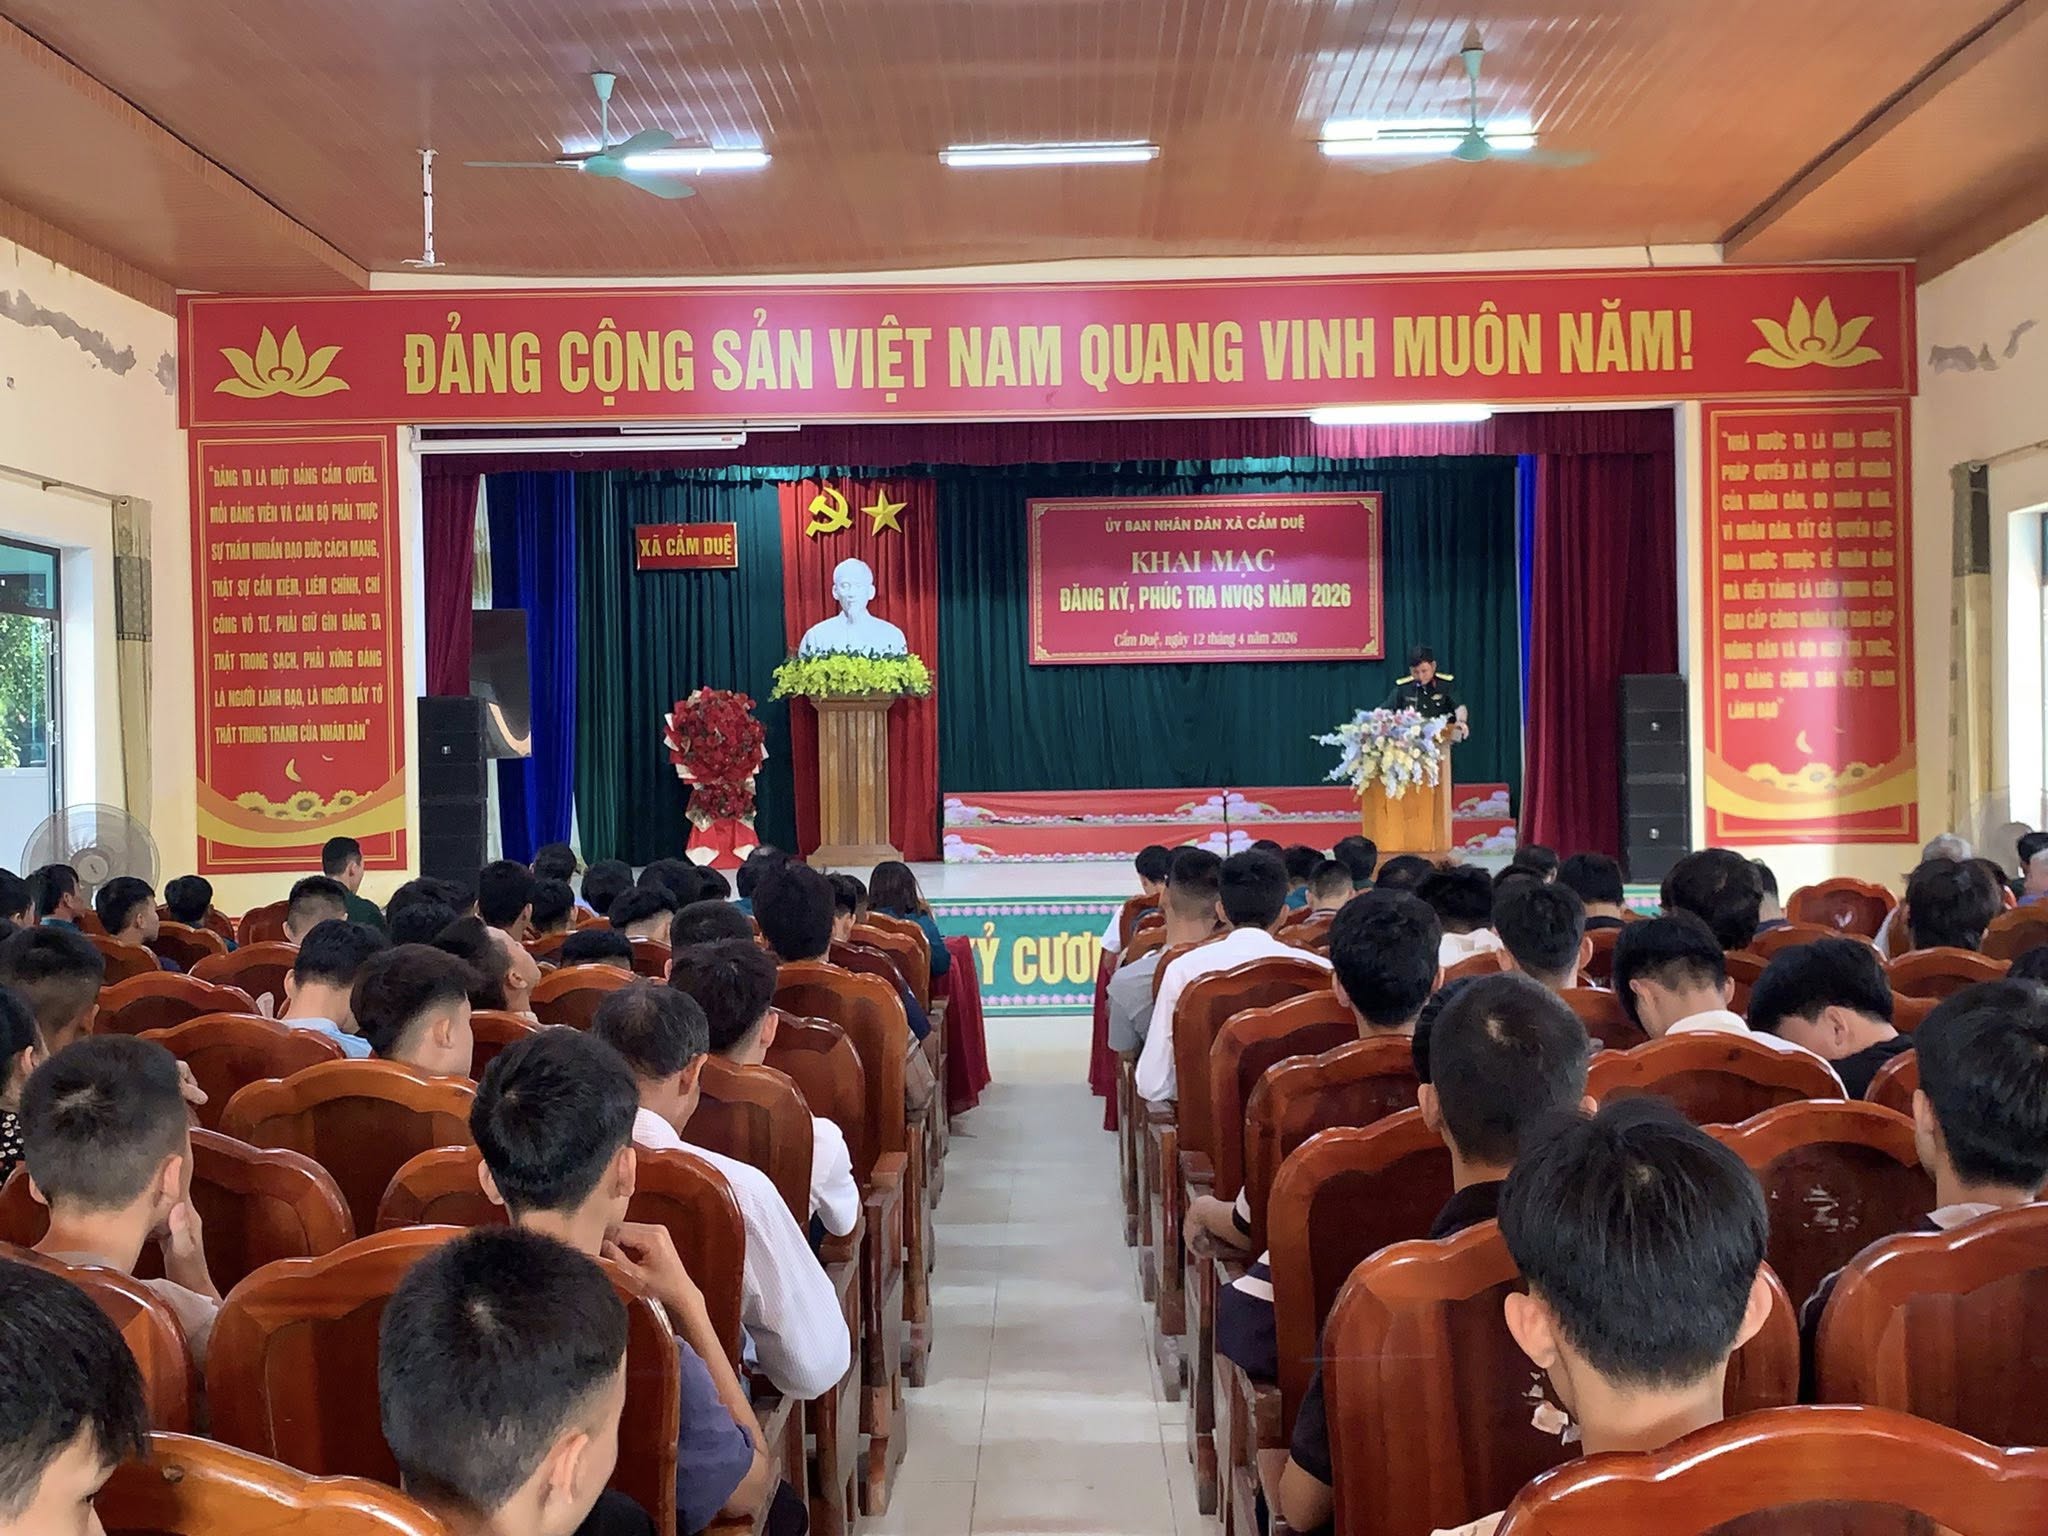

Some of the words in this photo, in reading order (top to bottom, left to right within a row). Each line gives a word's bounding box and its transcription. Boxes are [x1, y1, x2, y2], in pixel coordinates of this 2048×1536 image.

[403, 311, 540, 394] ĐẢNG
[559, 317, 695, 406] CỘNG
[712, 307, 812, 391] SẢN
[828, 314, 931, 402] VIỆT
[948, 325, 1063, 387] NAM
[1079, 321, 1244, 393] QUANG
[1260, 317, 1374, 381] VINH
[1393, 301, 1541, 378] MUÔN
[1558, 298, 1693, 373] NĂM!
[1105, 517, 1122, 533] ỦY
[1125, 519, 1150, 532] BAN
[1155, 516, 1191, 532] NHÂN
[1194, 516, 1222, 531] DÂN
[1225, 515, 1244, 530] XÃ
[1247, 511, 1277, 530] CẨM
[1280, 514, 1305, 533] DUỆ
[640, 534, 662, 557] XÃ
[666, 529, 699, 556] CẨM
[704, 533, 732, 560] DUỆ
[1131, 550, 1201, 574] KHAI
[1211, 549, 1275, 578] MẠC
[1060, 583, 1104, 612] ĐĂNG
[1109, 582, 1135, 613] KÝ,
[1139, 581, 1182, 610] PHÚC
[1187, 585, 1217, 609] TRA
[1221, 584, 1264, 611] NVQS
[1269, 579, 1307, 608] NĂM
[1311, 583, 1351, 608] 2026
[1165, 632, 1189, 648] ngày
[1193, 633, 1205, 645] 12
[1207, 631, 1236, 648] tháng
[1238, 633, 1244, 644] 4
[1247, 631, 1270, 644] năm
[1271, 632, 1298, 644] 2026
[969, 922, 1000, 985] Ỷ
